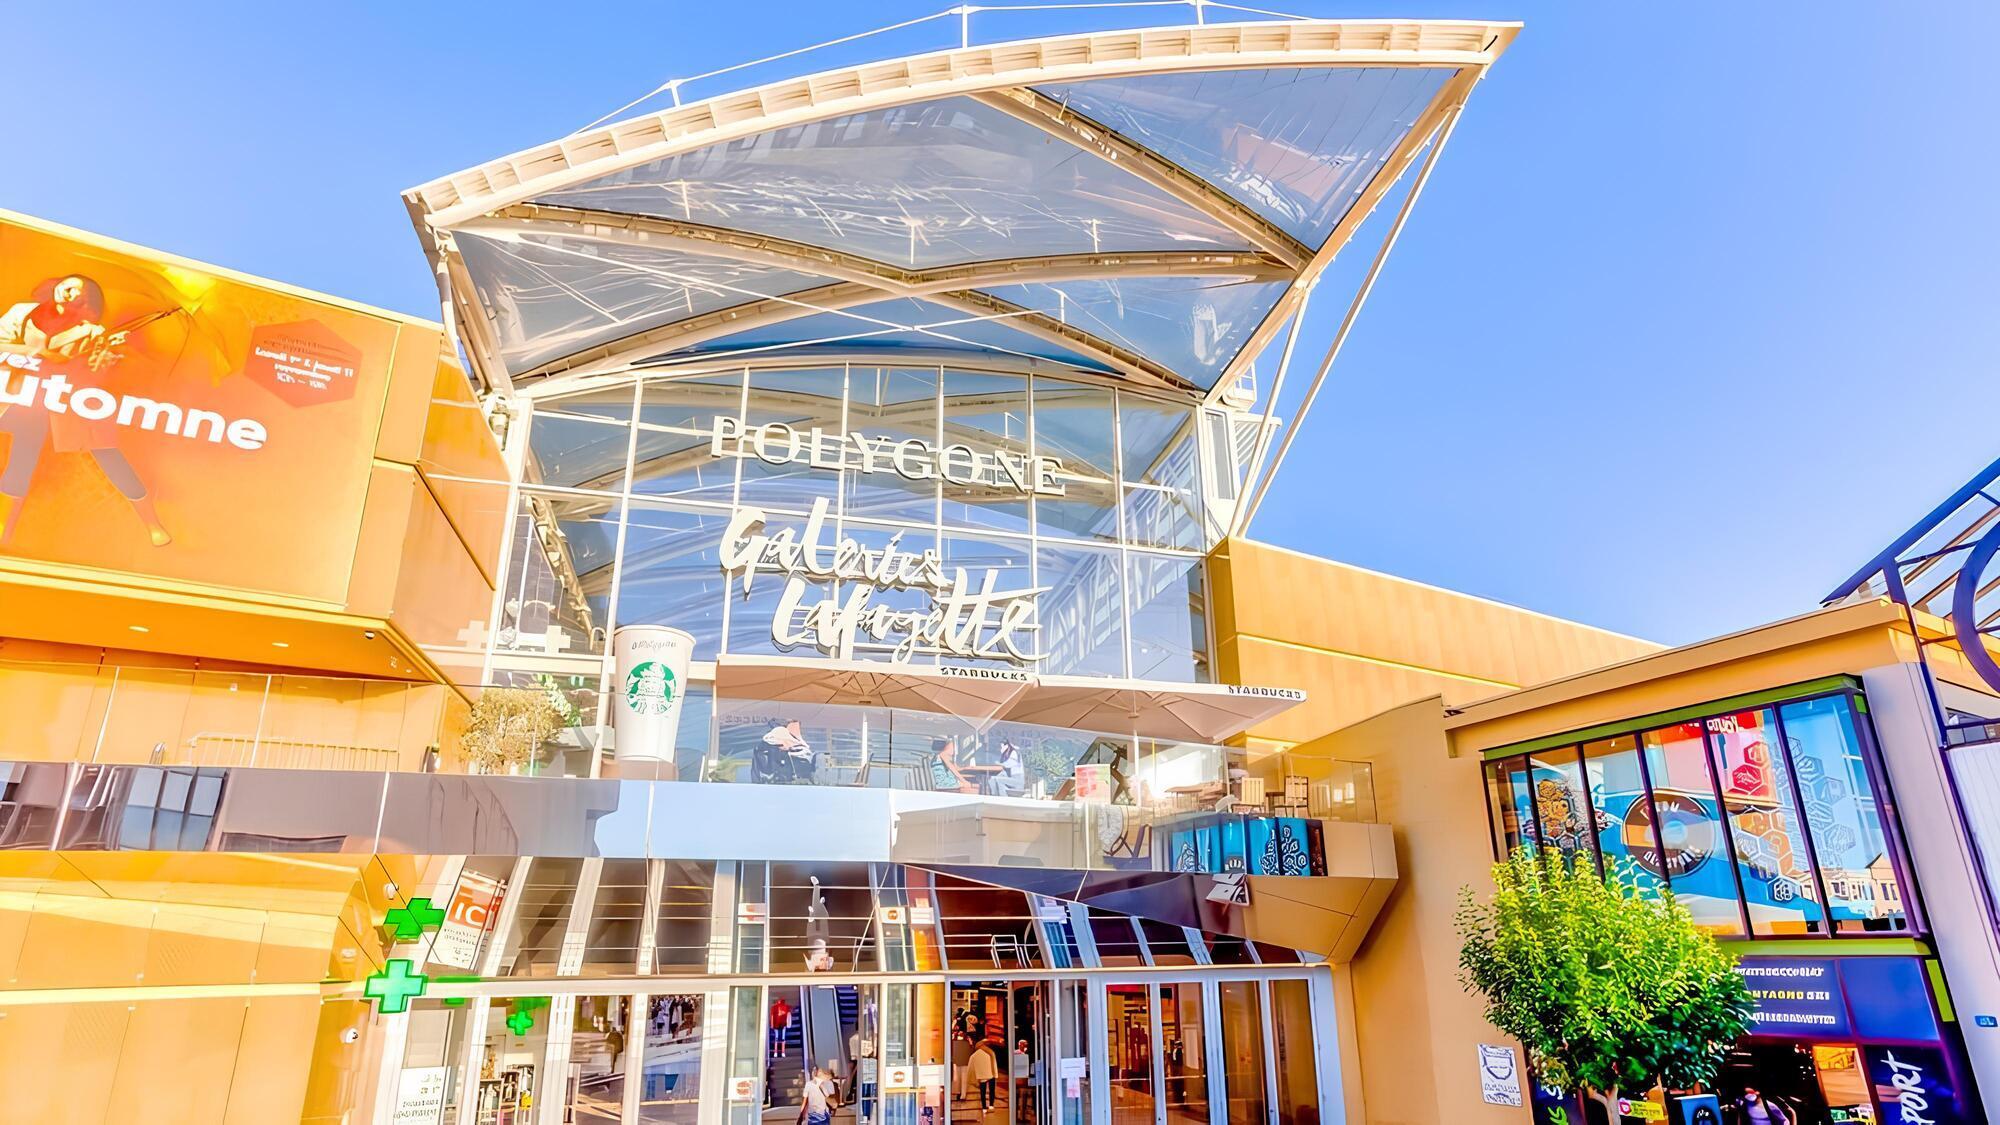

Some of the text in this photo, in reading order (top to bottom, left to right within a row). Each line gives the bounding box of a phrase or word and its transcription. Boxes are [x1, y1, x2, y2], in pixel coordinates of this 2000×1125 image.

[0, 370, 267, 450] utomne
[711, 415, 1066, 497] POLYGONE
[719, 497, 953, 600] Galeries
[771, 567, 1053, 664] Lafayette
